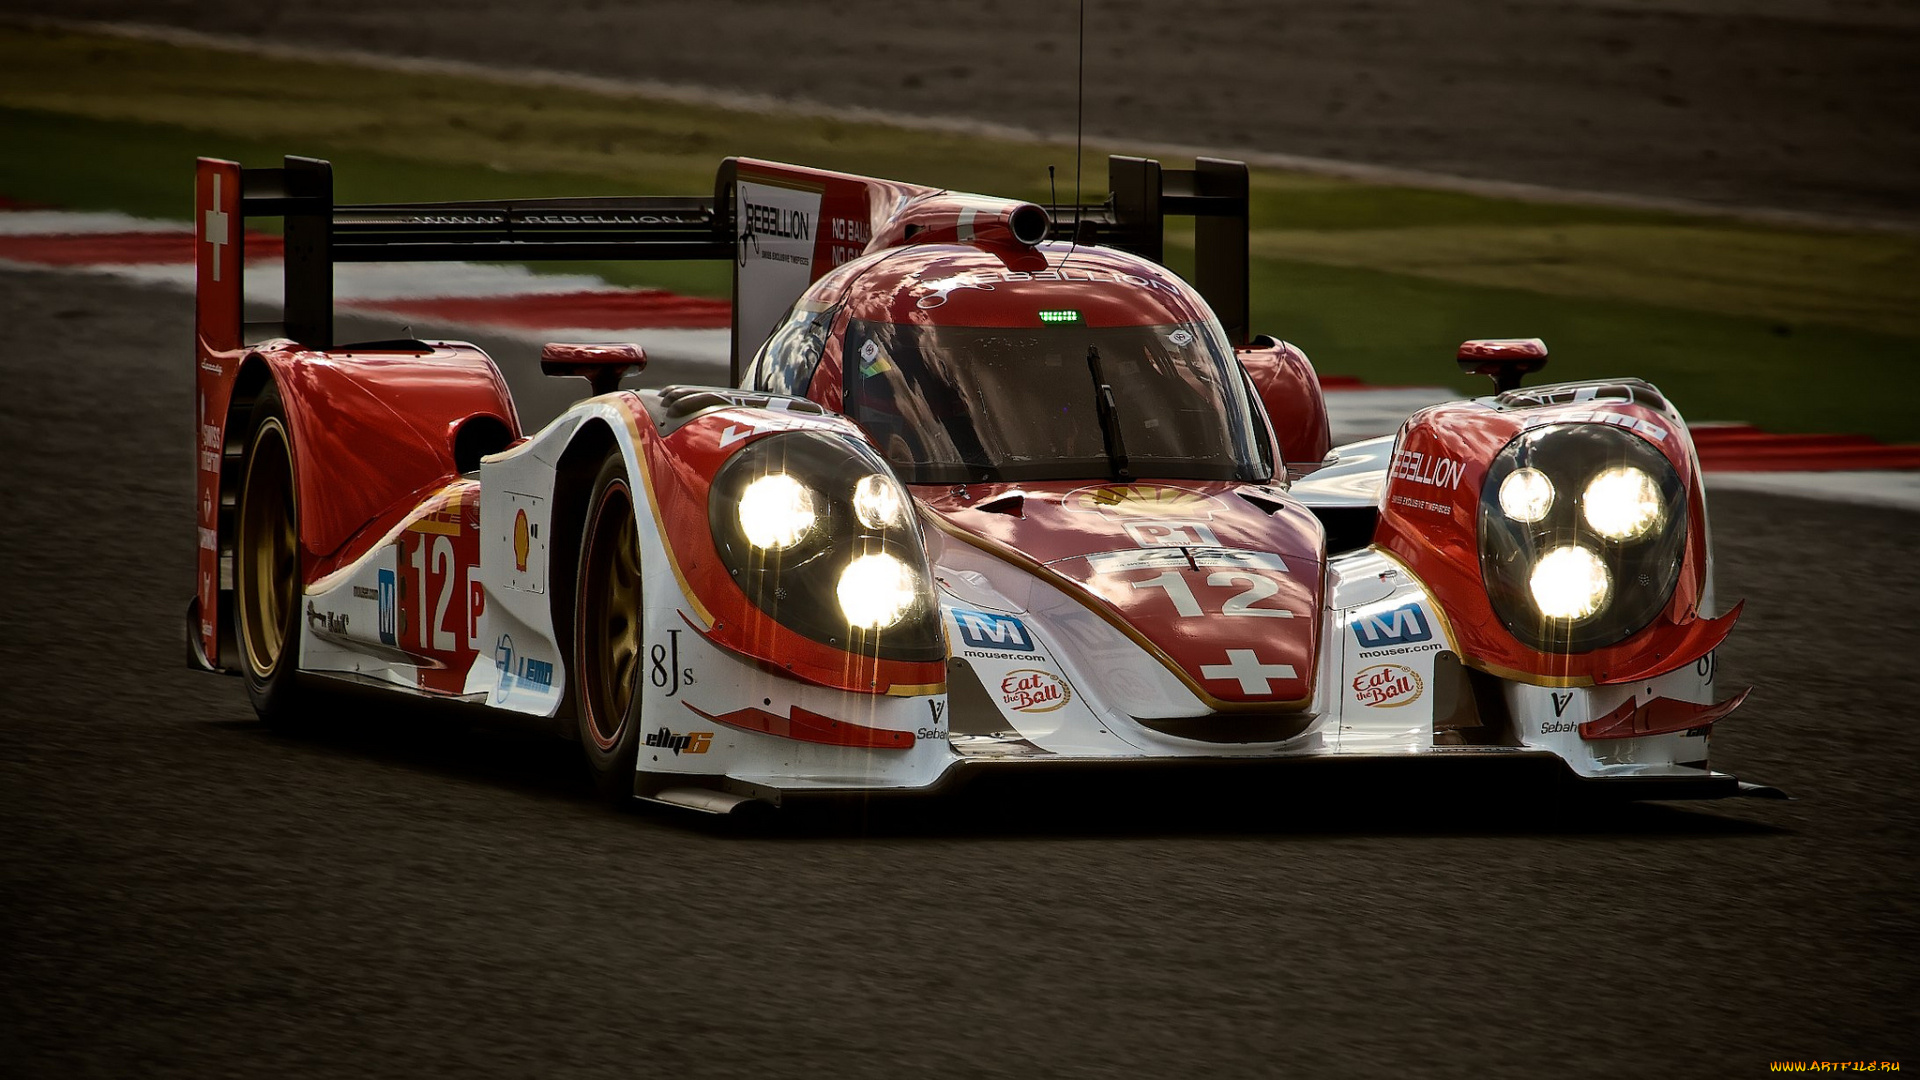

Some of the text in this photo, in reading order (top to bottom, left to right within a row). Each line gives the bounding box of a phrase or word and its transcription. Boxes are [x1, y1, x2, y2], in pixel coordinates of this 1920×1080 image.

[832, 217, 845, 240] NO
[832, 245, 845, 267] NO
[970, 270, 1181, 297] EBELLION
[1391, 449, 1467, 491] EBELLION
[1135, 525, 1205, 544] P1
[411, 534, 457, 652] 12
[1131, 571, 1294, 618] 12
[963, 650, 1046, 662] mouser.com
[1358, 643, 1443, 659] mouser.com
[1001, 673, 1044, 694] Eat
[1352, 668, 1395, 692] Eat
[1356, 676, 1415, 707] the Ball
[1003, 684, 1062, 710] the Ball
[1540, 721, 1577, 735] Sebah
